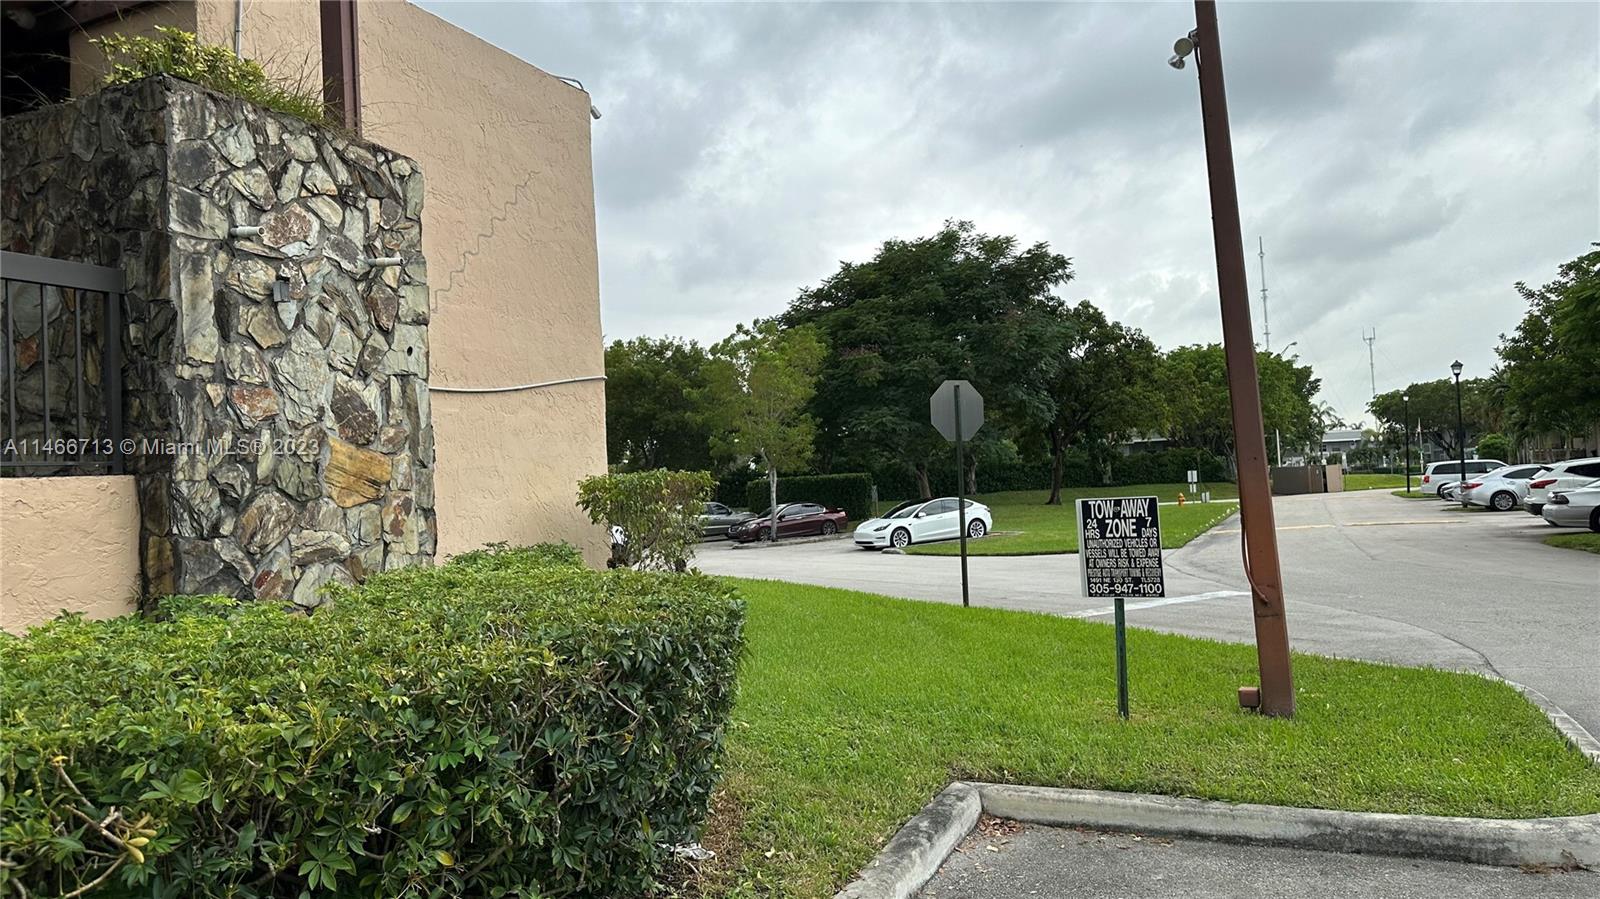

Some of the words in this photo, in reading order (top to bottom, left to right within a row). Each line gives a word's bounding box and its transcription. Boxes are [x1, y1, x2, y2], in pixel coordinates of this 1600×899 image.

[1086, 519, 1098, 529] 24
[1145, 517, 1152, 527] 7
[1105, 519, 1137, 538] ZONE
[1142, 527, 1158, 538] DAYS
[1085, 529, 1100, 539] HRS
[1086, 539, 1123, 548] UNAUTHORIZED
[1124, 538, 1148, 548] VEHICLES
[1149, 538, 1158, 547] OR
[1086, 548, 1107, 558] VESSELS
[1108, 548, 1120, 558] WILL
[1120, 548, 1128, 558] BE
[1128, 548, 1146, 558] TOWED
[1148, 548, 1160, 557] AWAY
[1088, 559, 1094, 568] AT
[1096, 559, 1117, 568] OWNERS
[1118, 558, 1130, 568] RISK
[1136, 558, 1159, 568] EXPENSE
[1090, 584, 1162, 594] 305-947-1100
